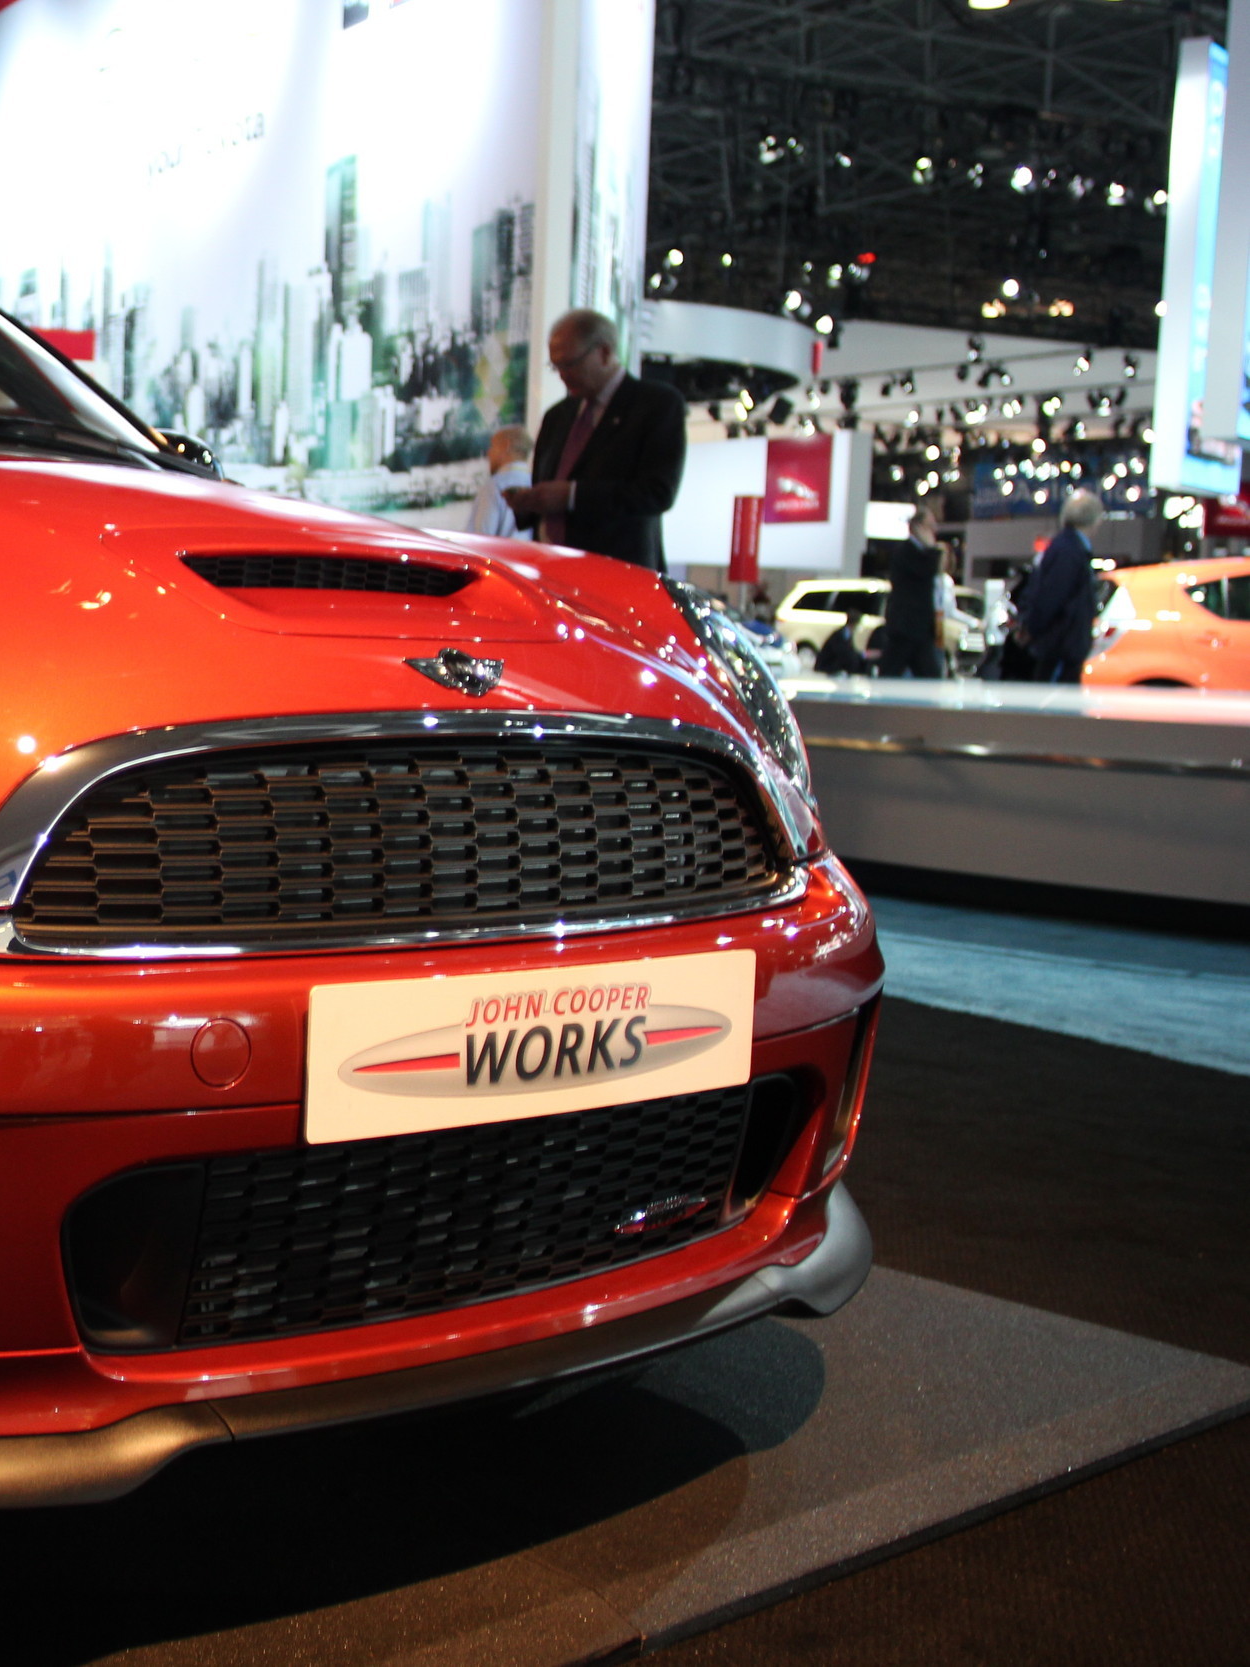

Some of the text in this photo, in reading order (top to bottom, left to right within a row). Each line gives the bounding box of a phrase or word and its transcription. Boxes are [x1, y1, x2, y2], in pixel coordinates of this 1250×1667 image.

[466, 985, 650, 1028] JOHN COOPER
[466, 1015, 647, 1086] WORKS
